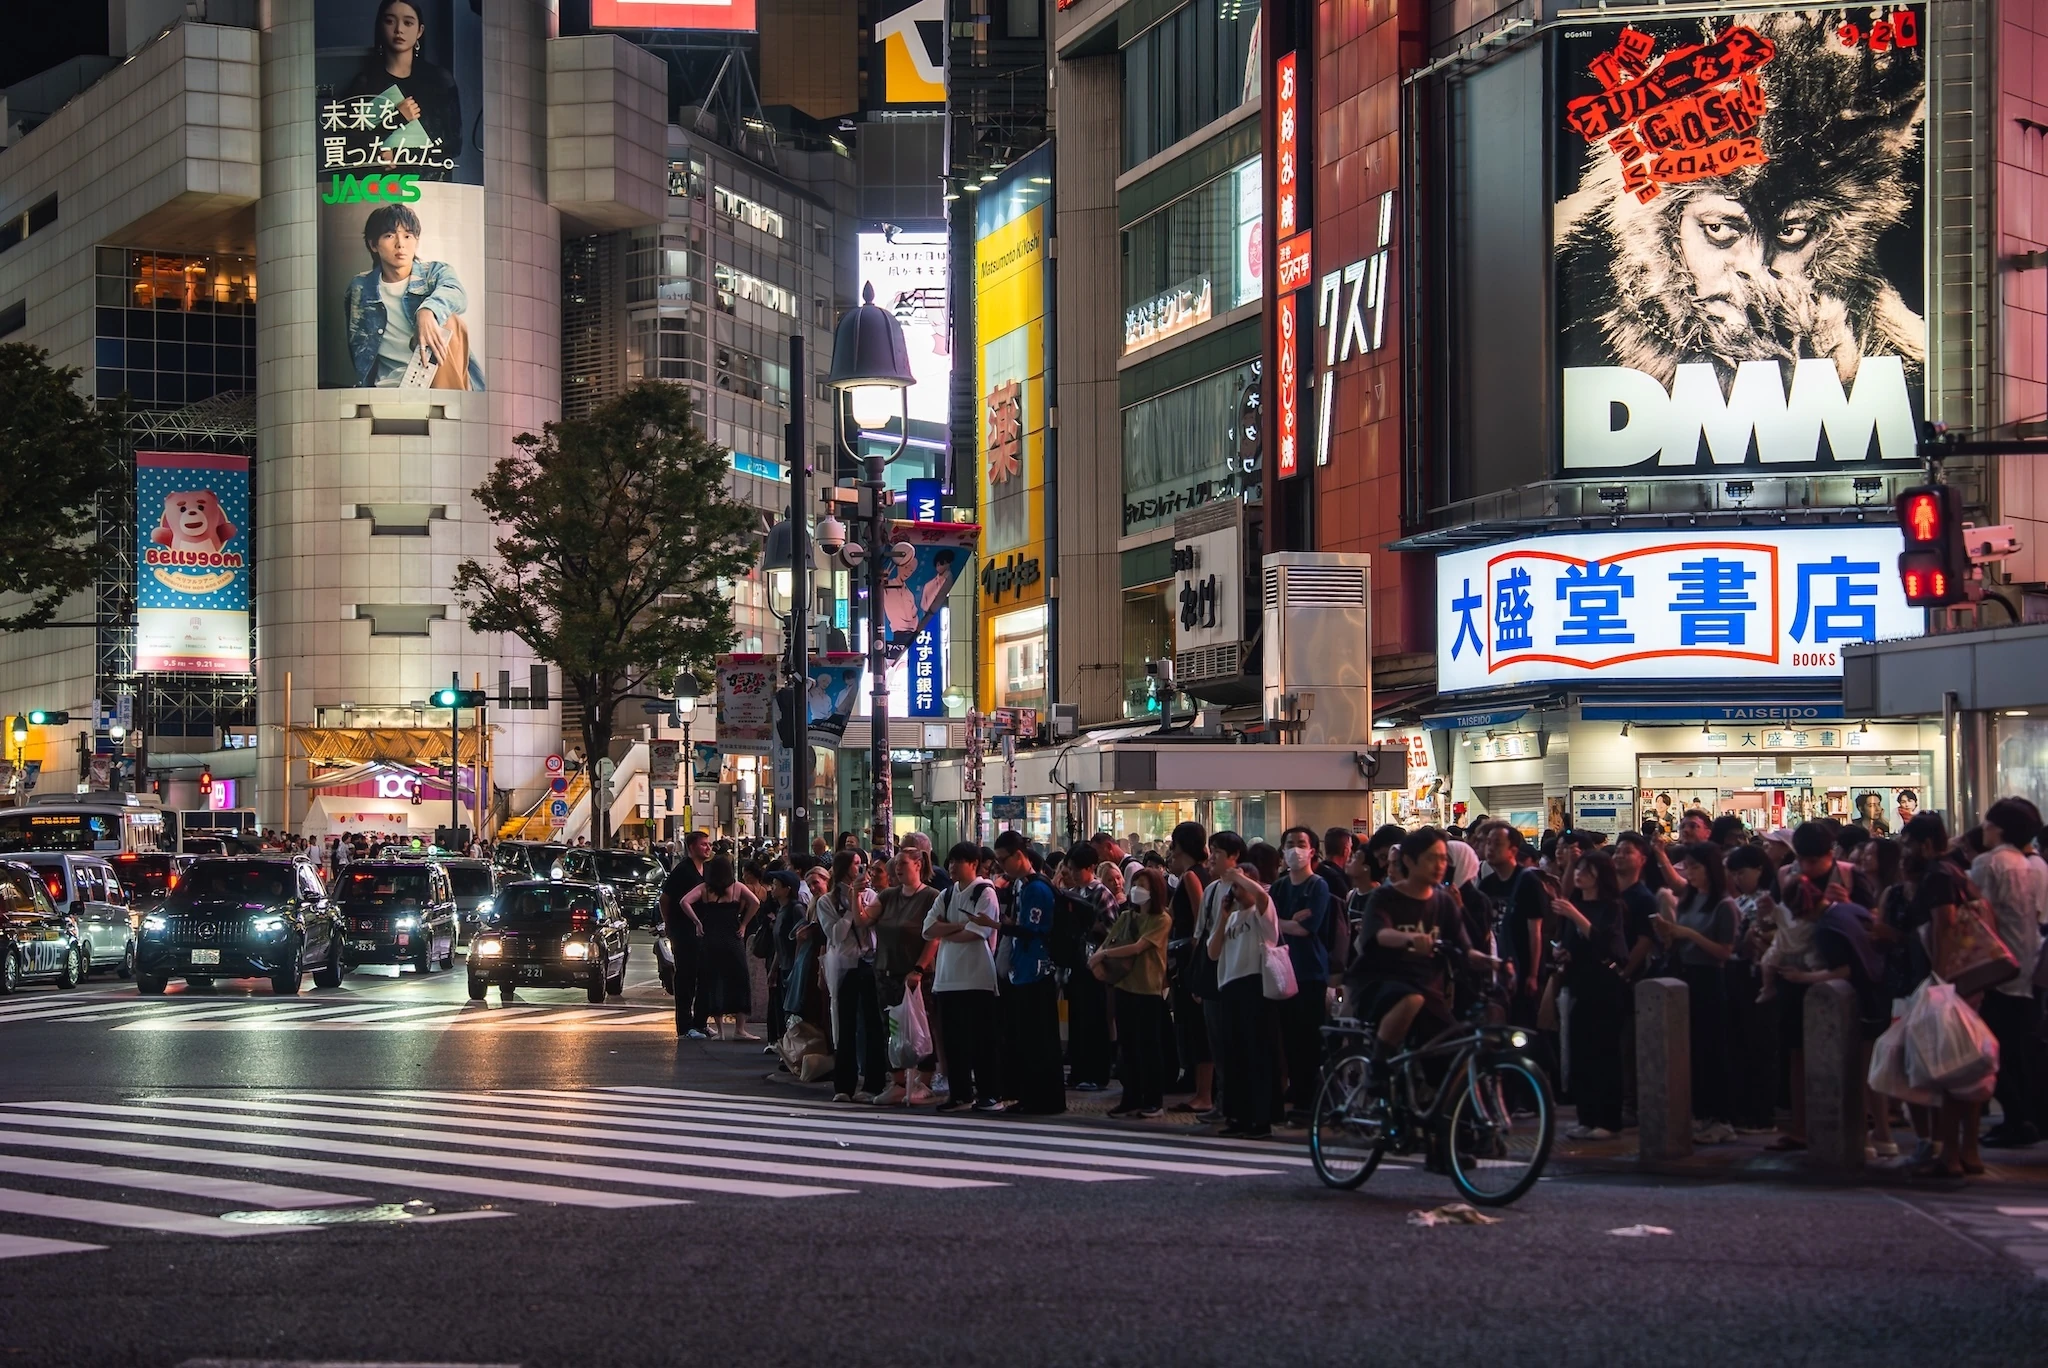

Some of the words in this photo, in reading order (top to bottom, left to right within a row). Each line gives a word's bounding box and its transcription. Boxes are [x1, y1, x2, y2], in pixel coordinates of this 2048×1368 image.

[322, 98, 406, 132] 未来を、
[323, 135, 455, 170] 買ったんだ。
[1280, 67, 1295, 229] お好み焼
[321, 173, 422, 205] JACCS
[981, 249, 1016, 280] Matsumoto
[1016, 229, 1040, 260] KiYoshi
[1281, 304, 1294, 469] もんじゃ焼
[1563, 356, 1919, 468] DMM
[988, 378, 1021, 486] 薬
[146, 549, 243, 568] Bellygom
[1451, 556, 1881, 662] 大盛堂書店
[163, 659, 176, 667] 9.5
[196, 660, 212, 668] 9.21
[916, 630, 933, 709] みずほ銀行
[1792, 653, 1836, 667] BOOKS
[1457, 716, 1492, 727] TAISEIDO
[1722, 708, 1818, 719] TAISEIDO
[1741, 731, 1861, 747] 大盛堂書店
[549, 759, 559, 768] 30
